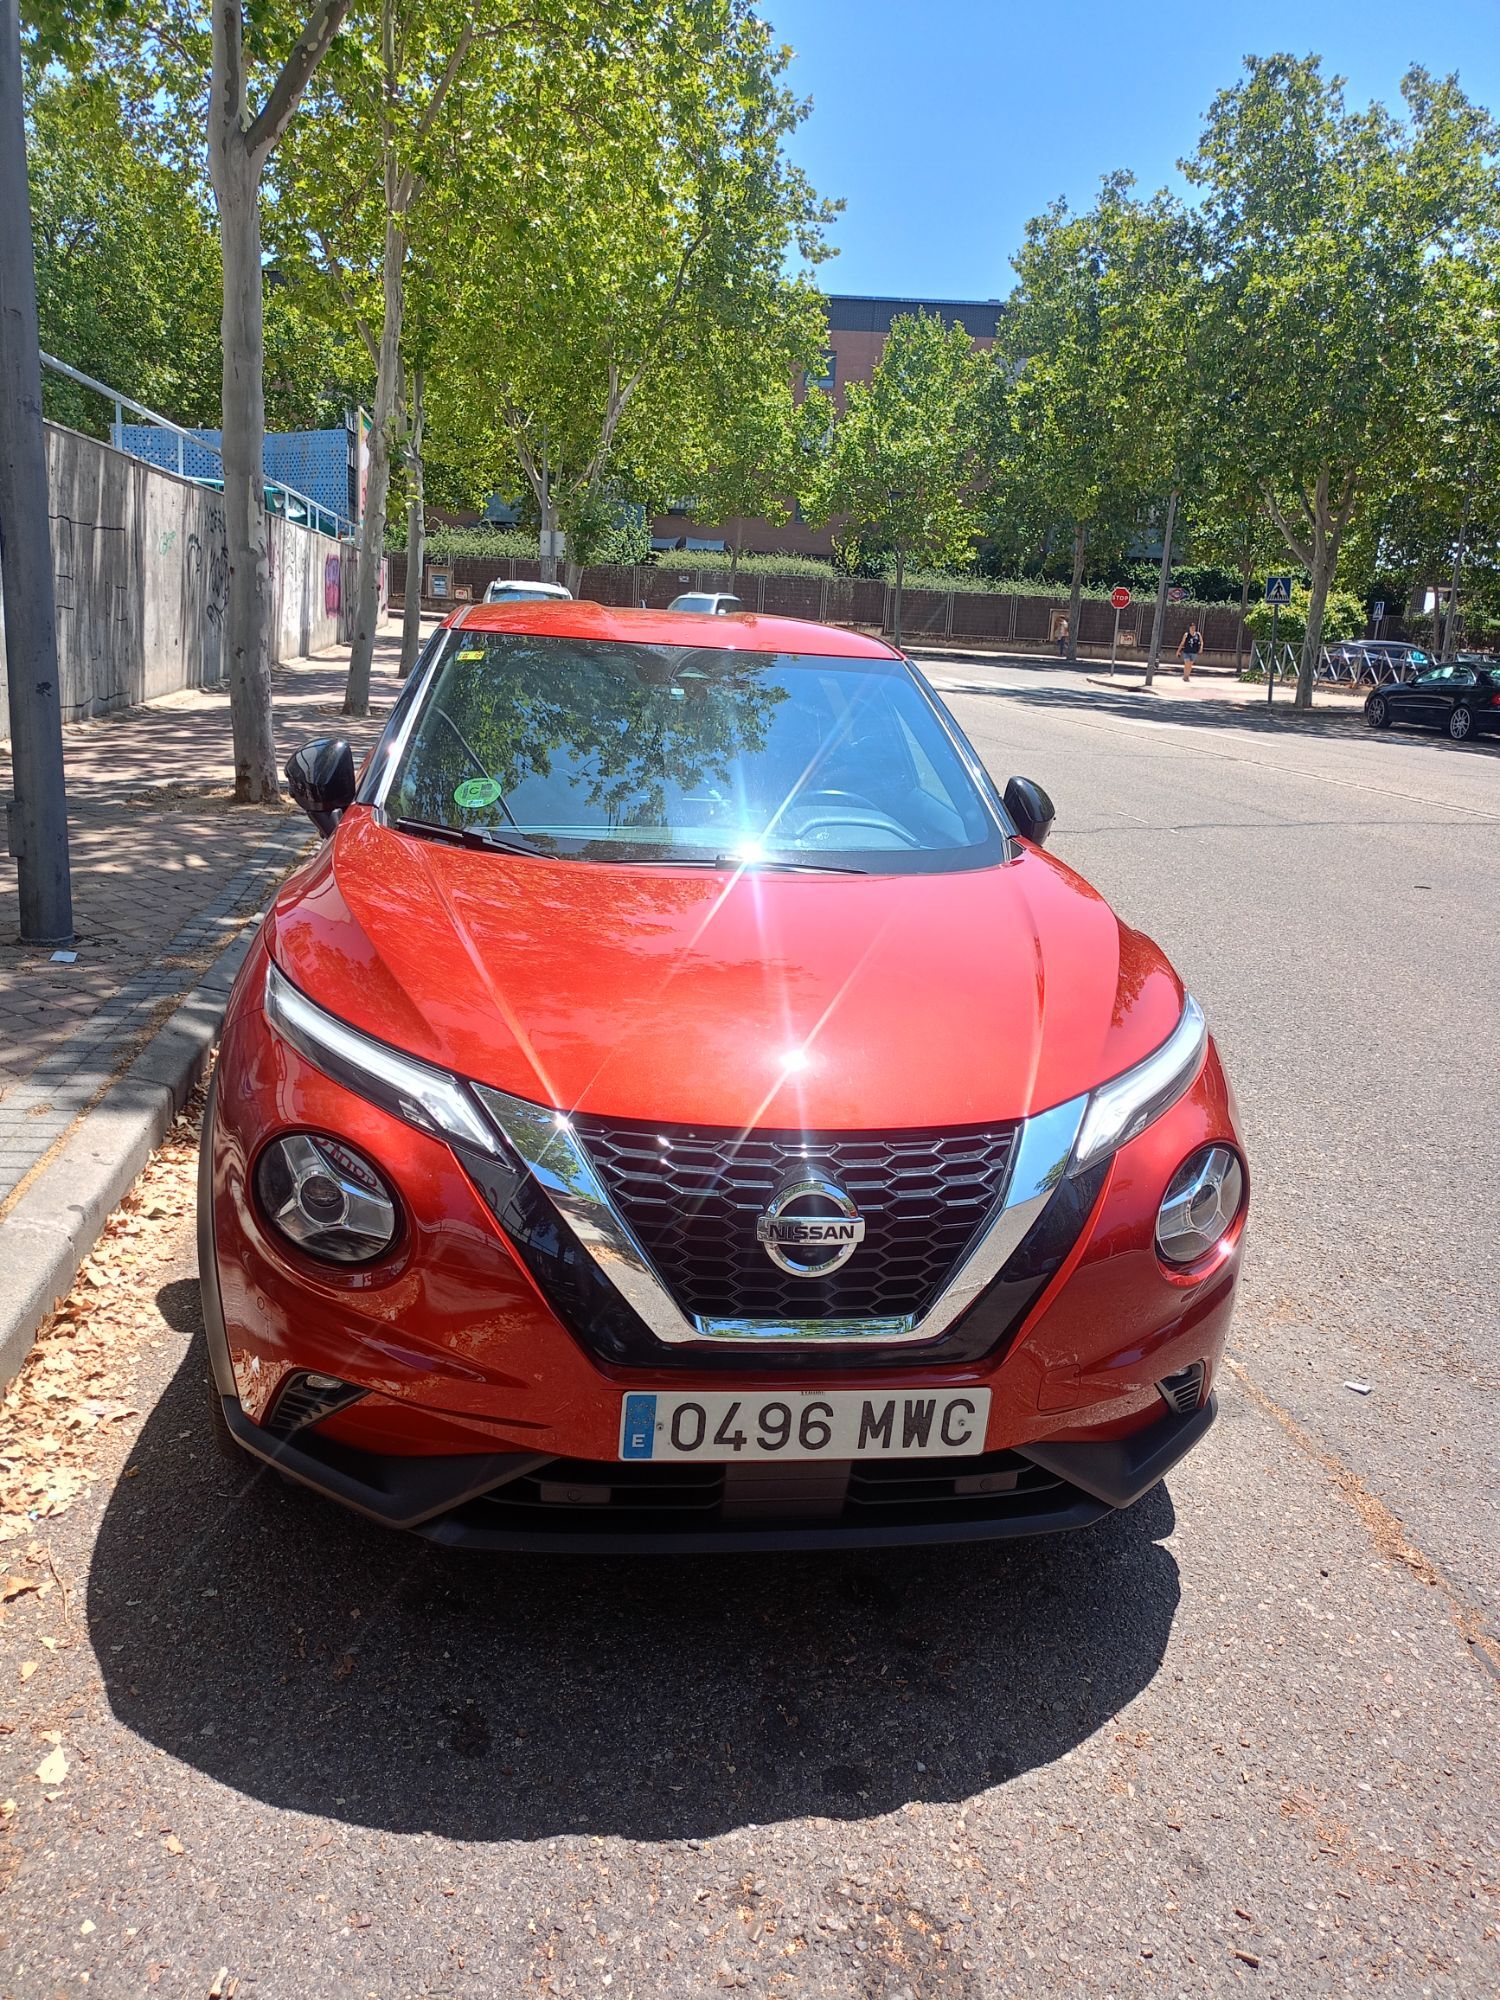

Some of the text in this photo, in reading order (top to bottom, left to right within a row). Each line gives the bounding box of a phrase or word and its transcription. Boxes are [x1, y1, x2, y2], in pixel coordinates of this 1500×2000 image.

[769, 1225, 855, 1240] NISSAN
[632, 1399, 976, 1451] E 0496 MWC
